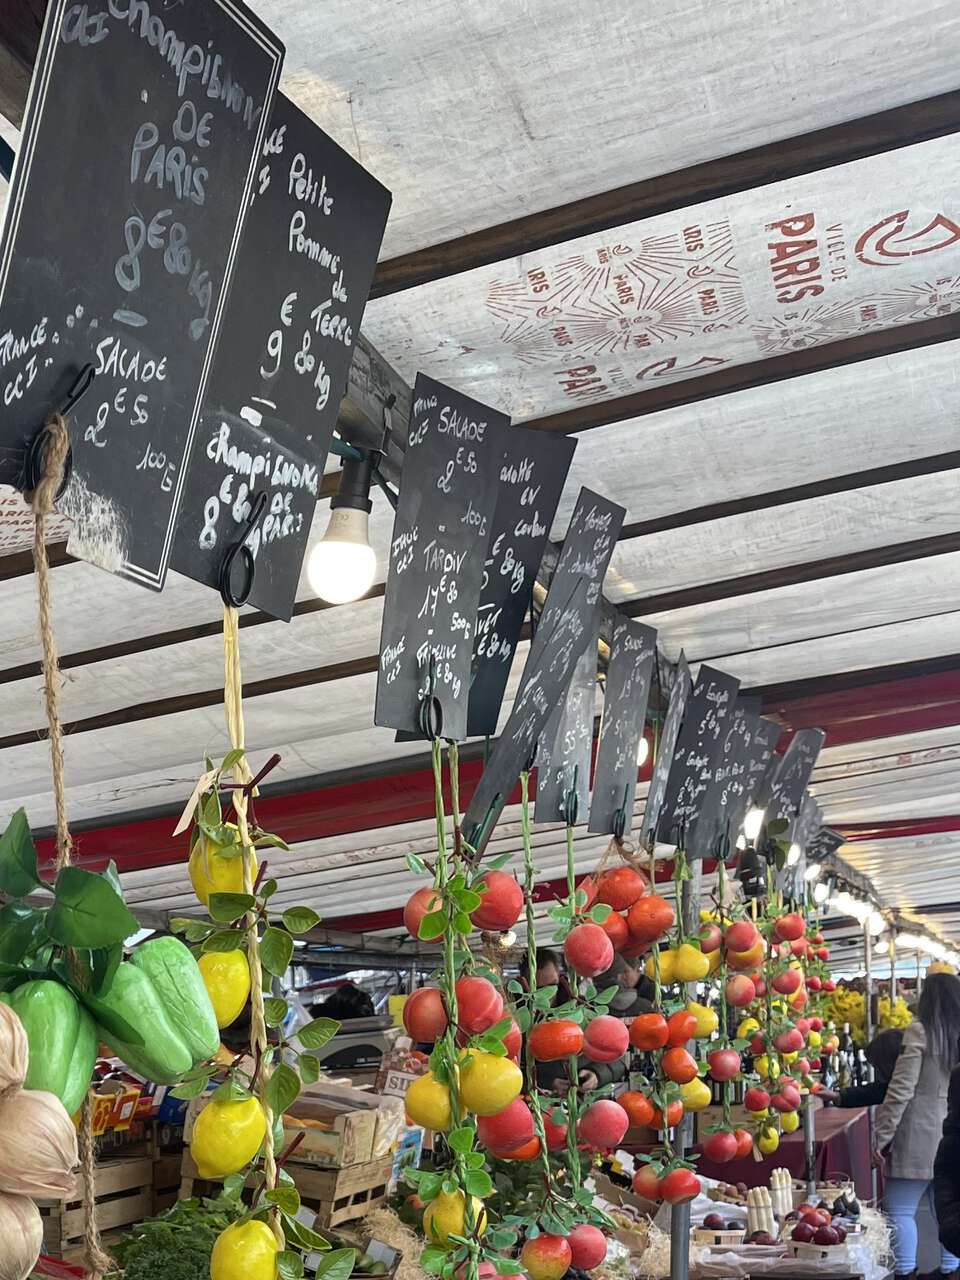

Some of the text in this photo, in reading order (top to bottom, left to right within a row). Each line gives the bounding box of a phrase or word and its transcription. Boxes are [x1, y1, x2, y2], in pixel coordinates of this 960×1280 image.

[173, 101, 214, 147] DE
[767, 212, 825, 304] PARIS
[95, 337, 167, 382] SALADE
[437, 406, 488, 442] SALADE
